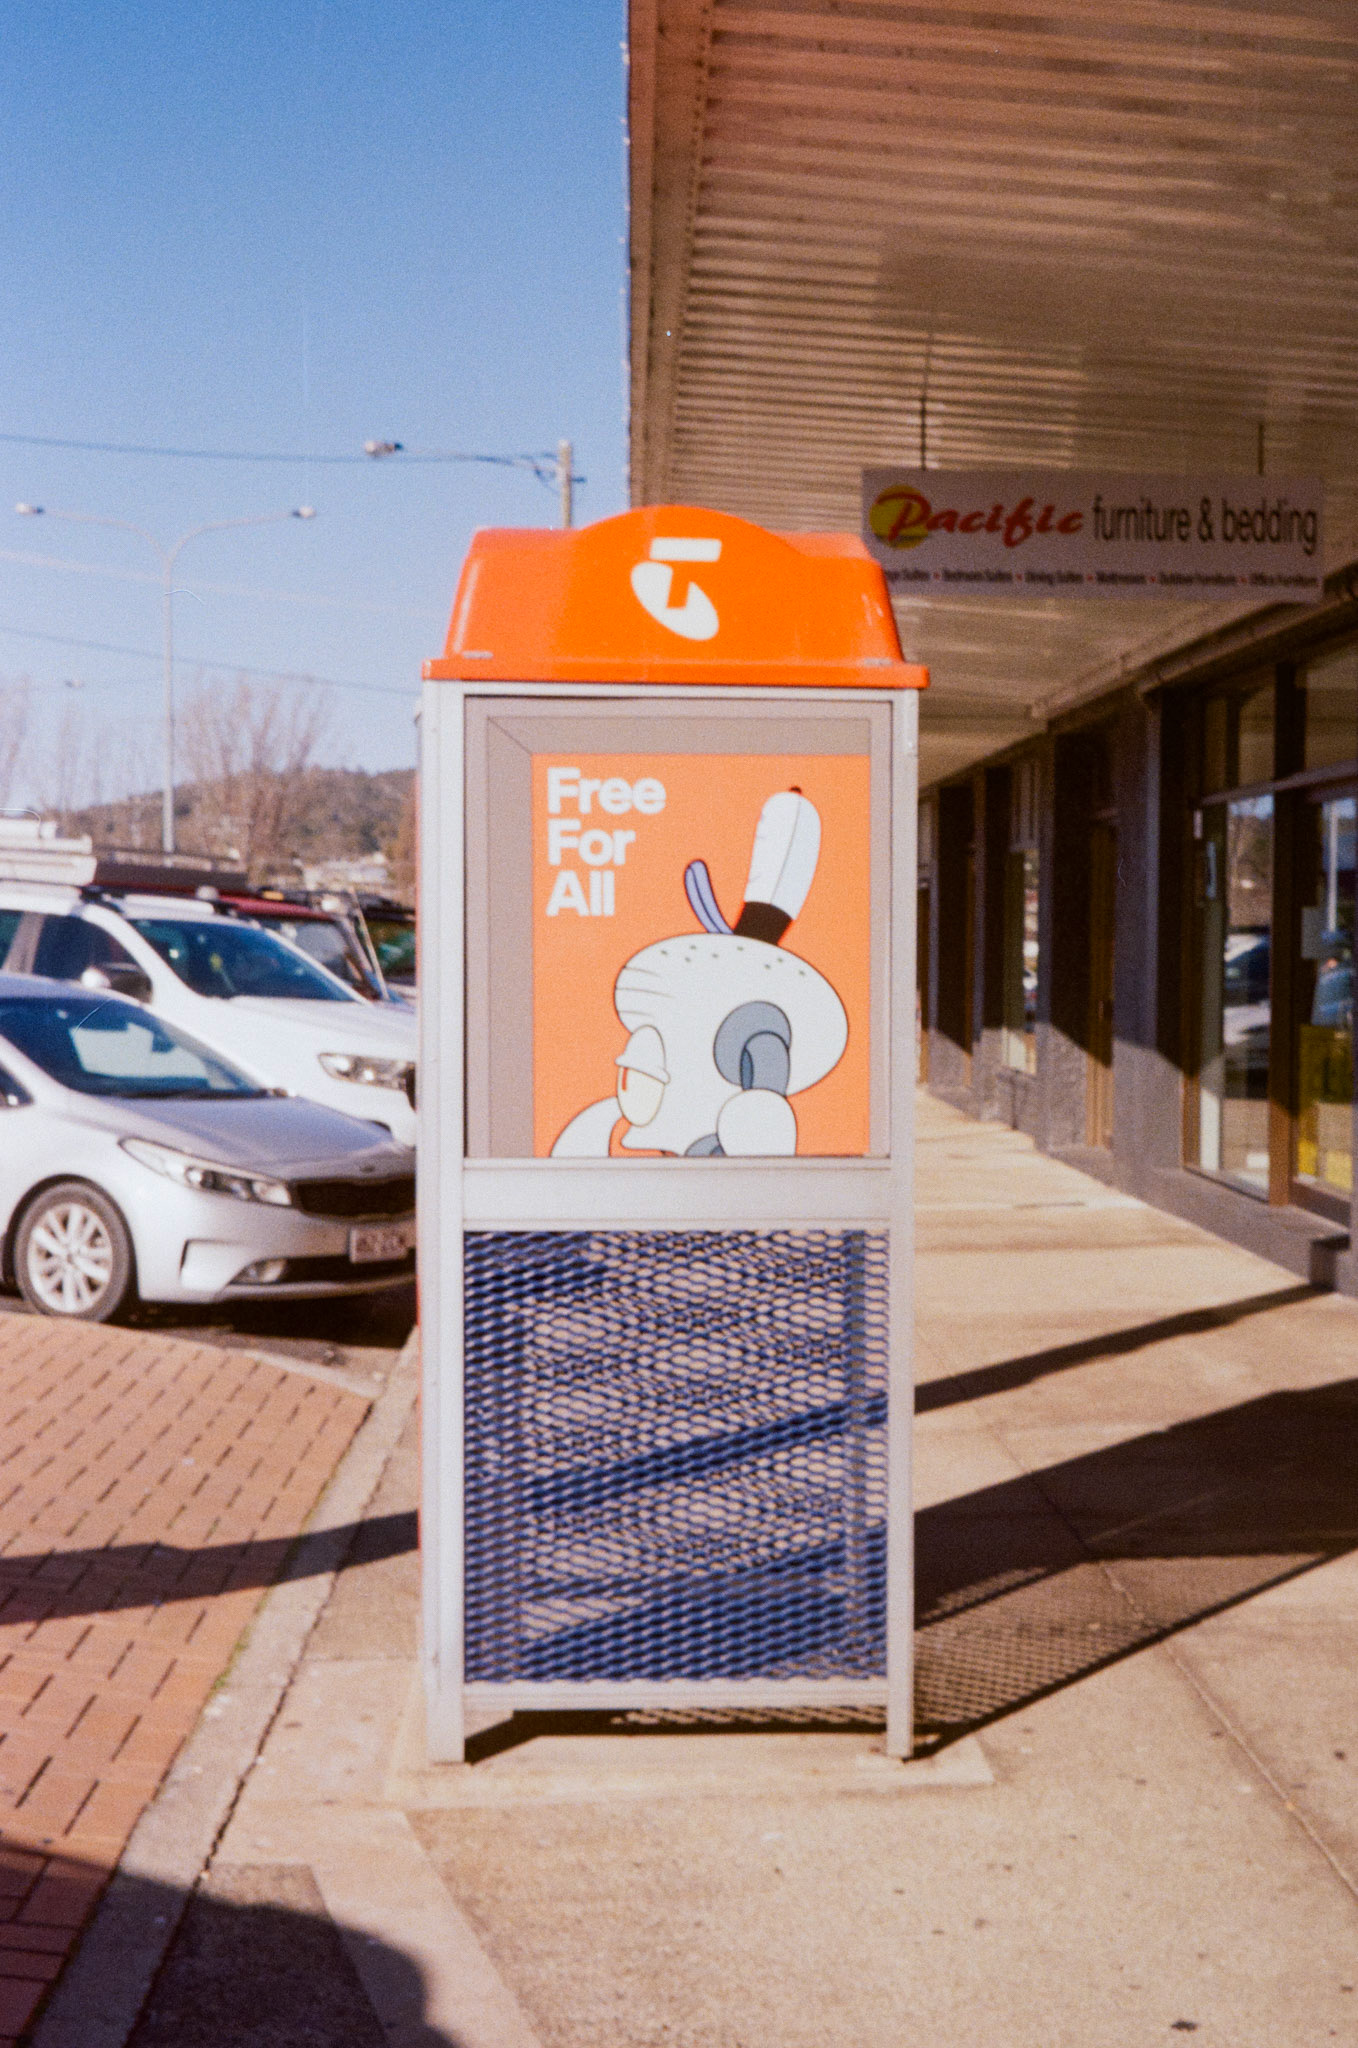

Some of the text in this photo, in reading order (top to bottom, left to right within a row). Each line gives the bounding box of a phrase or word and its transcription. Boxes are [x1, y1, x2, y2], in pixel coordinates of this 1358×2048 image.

[875, 491, 1317, 556] Pacific furniture & bedding
[547, 766, 667, 815] Free
[547, 818, 637, 866] For
[545, 870, 615, 917] All
